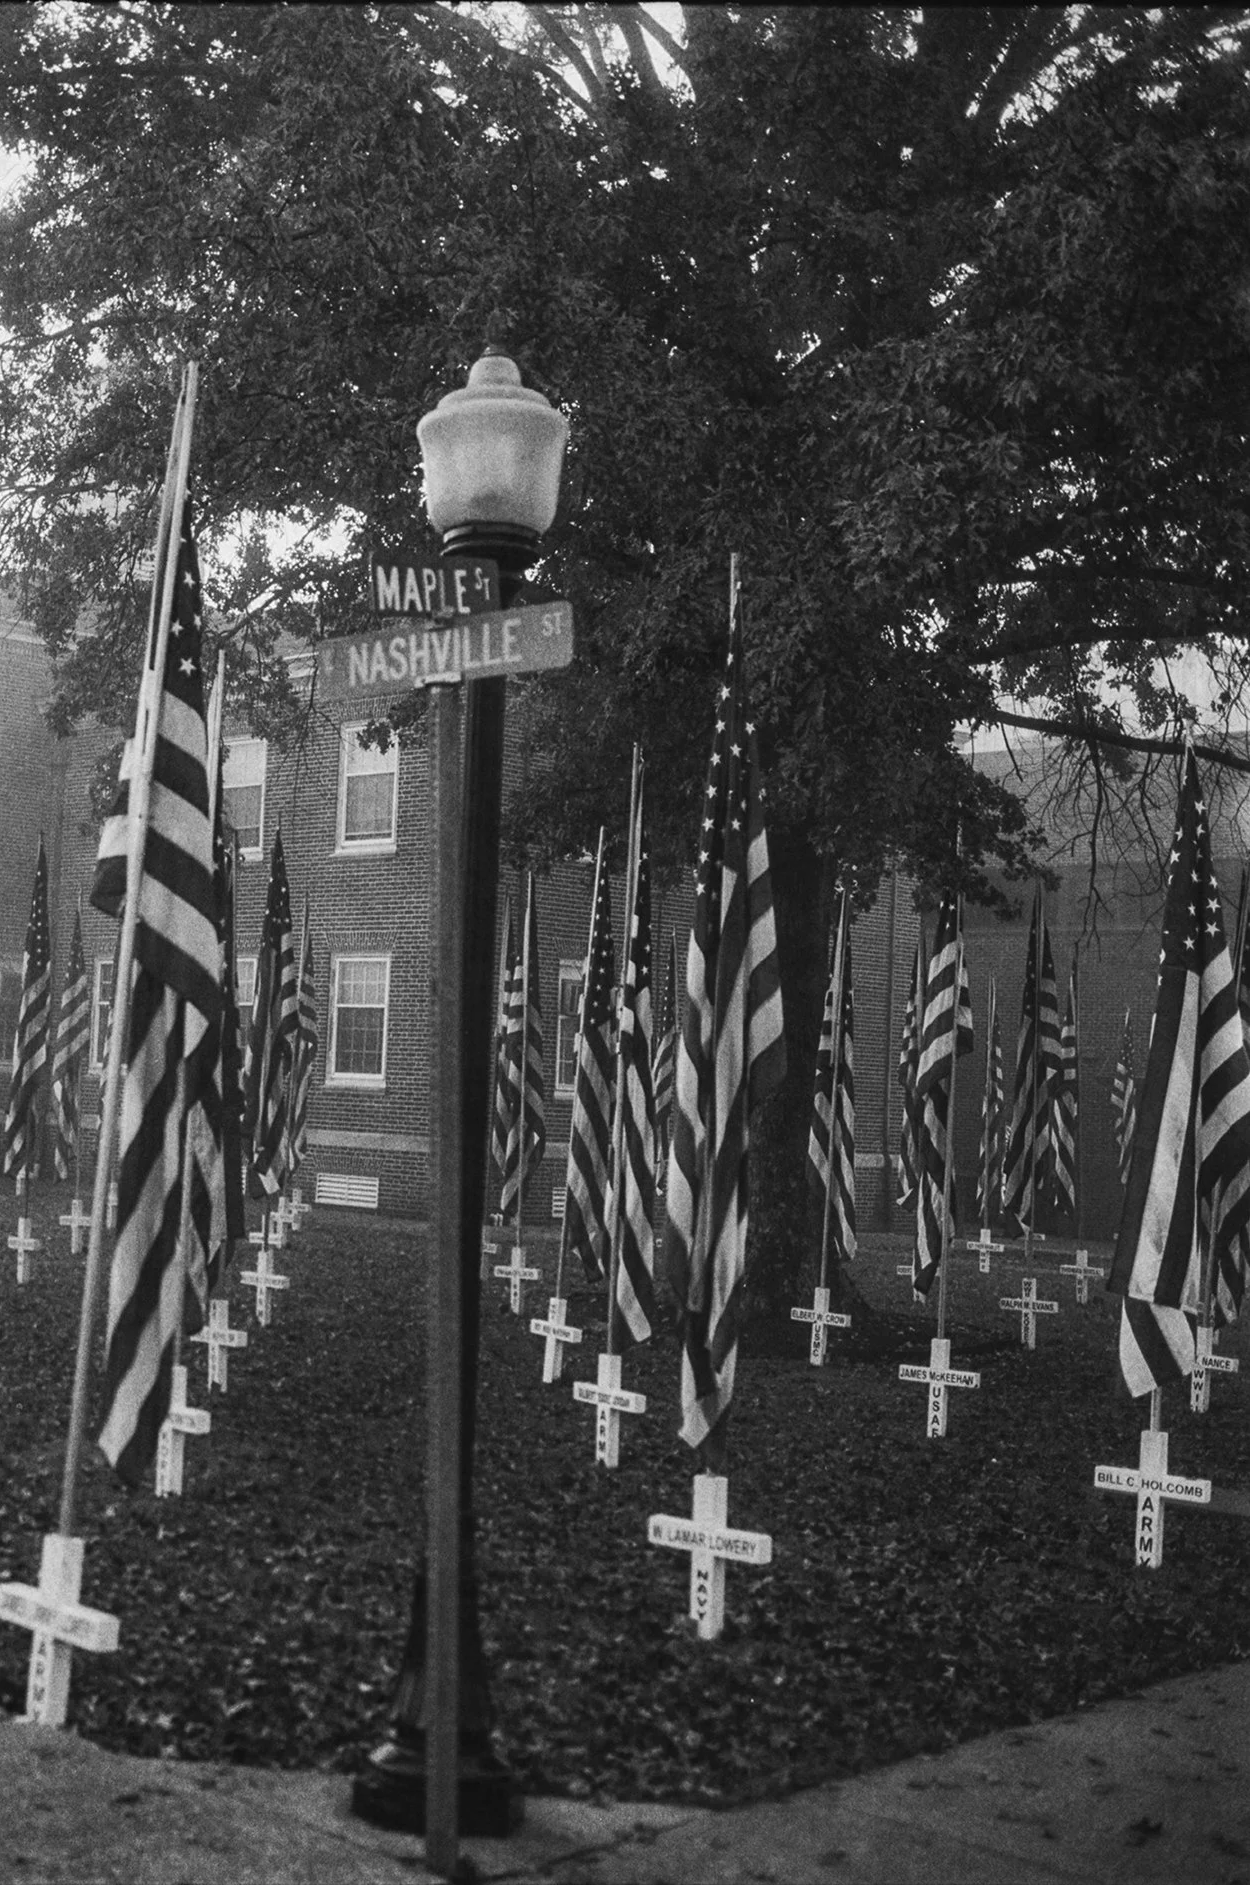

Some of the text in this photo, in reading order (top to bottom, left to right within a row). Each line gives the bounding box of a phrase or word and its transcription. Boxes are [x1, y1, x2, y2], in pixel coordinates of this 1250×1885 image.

[376, 565, 471, 614] MAPLE
[350, 617, 523, 686] NASHVILLE
[541, 611, 563, 637] ST
[792, 1309, 816, 1321] ELBERT
[825, 1314, 846, 1325] CROW
[1000, 1299, 1022, 1310] RALPH
[1032, 1302, 1055, 1311] EVANS
[812, 1324, 821, 1358] USMC
[899, 1368, 975, 1386] JAMES McKEEHAN
[1201, 1356, 1231, 1370] NANCE
[932, 1386, 942, 1438] USAF
[1097, 1472, 1123, 1486] BILL
[1141, 1478, 1204, 1498] HOLCOMB
[667, 1527, 707, 1546] LAMAR
[708, 1534, 758, 1559] LOWERY
[1139, 1496, 1154, 1568] ARMY
[697, 1569, 709, 1621] NAVY
